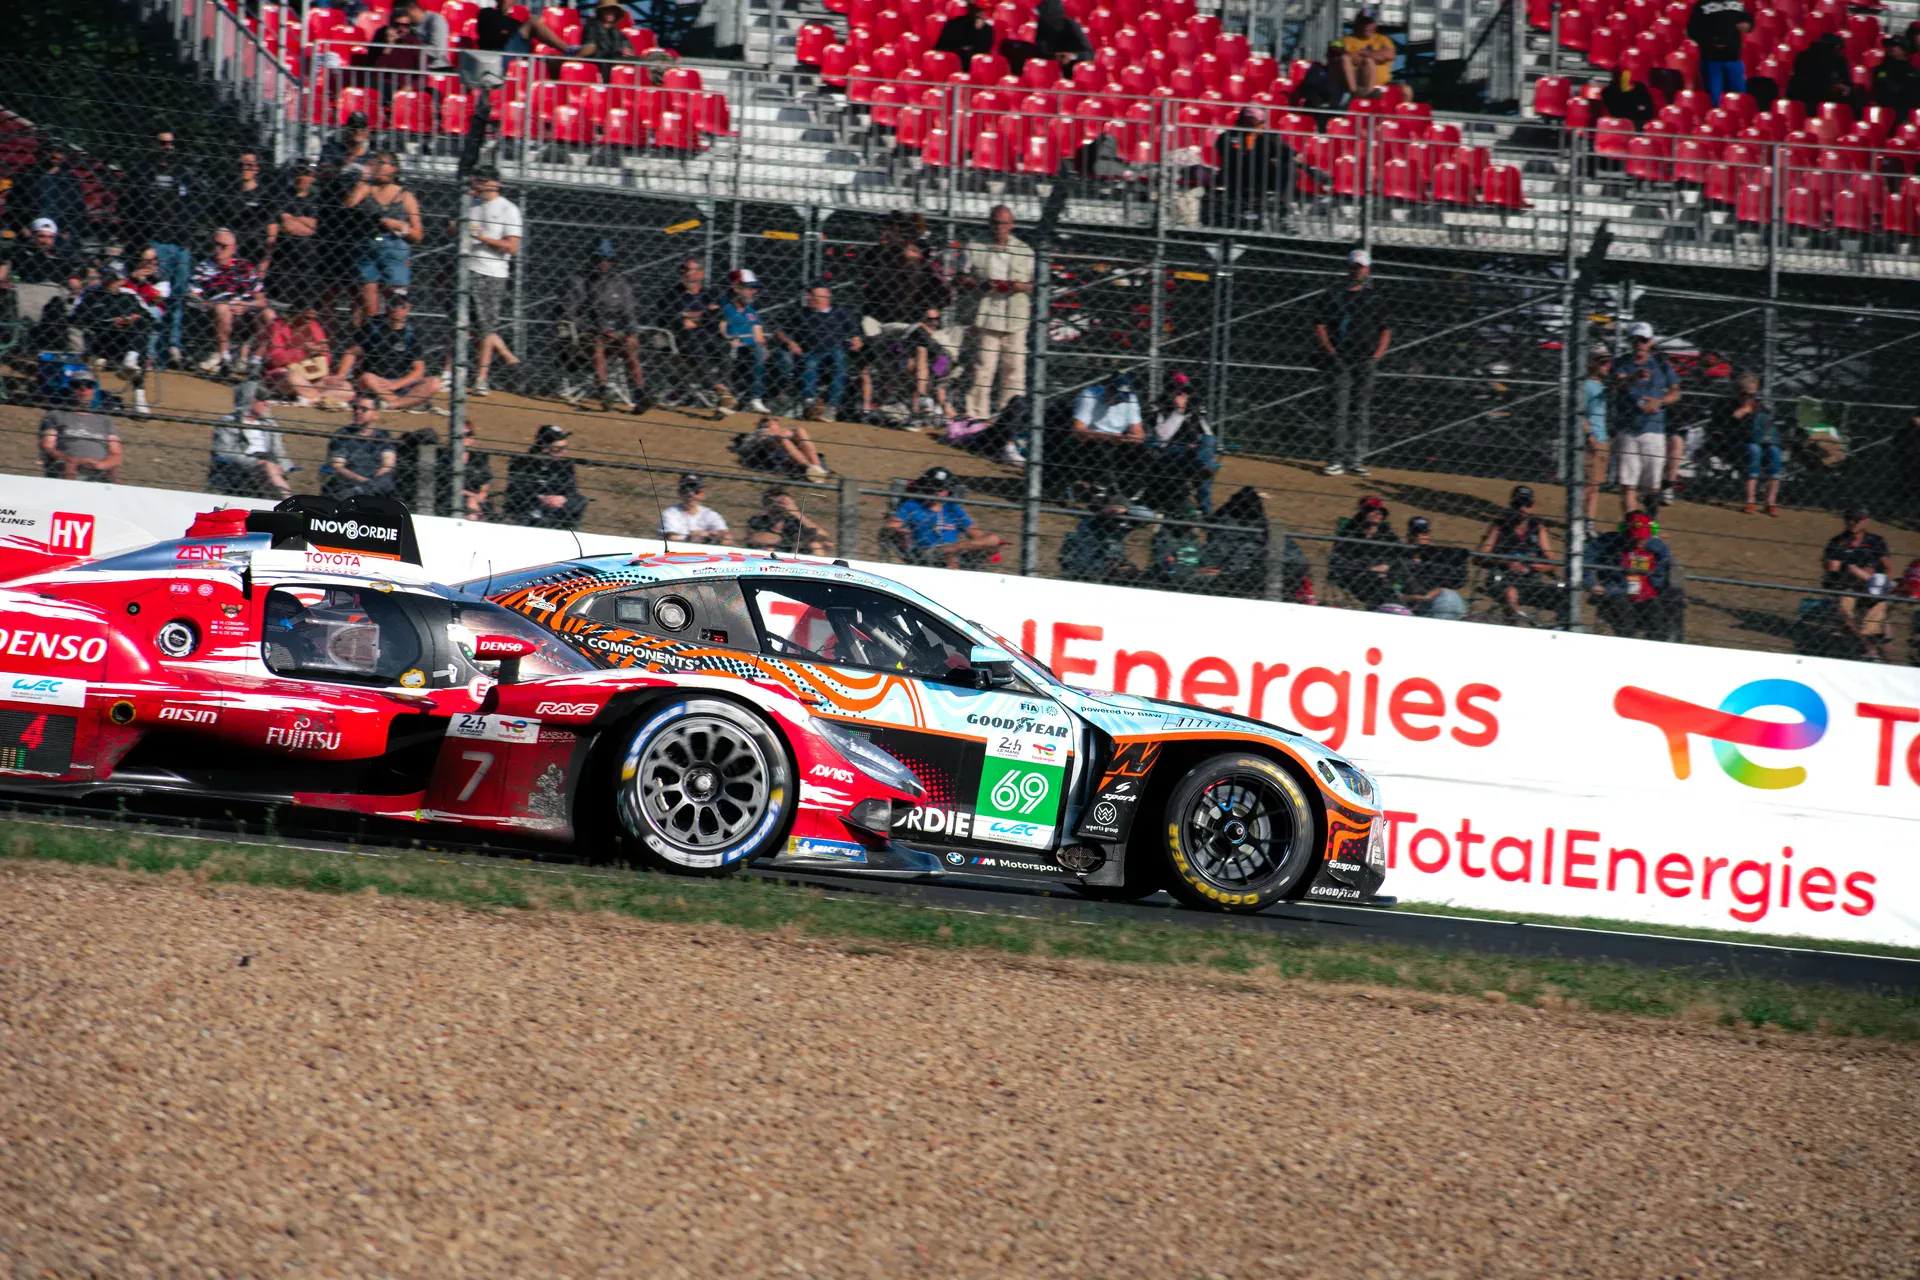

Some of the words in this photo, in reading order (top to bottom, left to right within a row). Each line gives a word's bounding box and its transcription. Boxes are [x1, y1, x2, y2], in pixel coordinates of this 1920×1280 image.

[0, 517, 36, 526] LINES
[52, 519, 92, 549] HY
[176, 545, 227, 560] ZENT
[305, 553, 361, 567] TOYOTA
[479, 641, 523, 653] DENSO
[535, 701, 599, 716] RAYS
[1080, 706, 1122, 714] powered
[20, 714, 48, 749] 4
[457, 751, 494, 801] 7
[991, 769, 1049, 814] 69
[1102, 794, 1137, 802] spark
[1000, 860, 1064, 872] Motorsport
[1328, 860, 1361, 871] Snap-on
